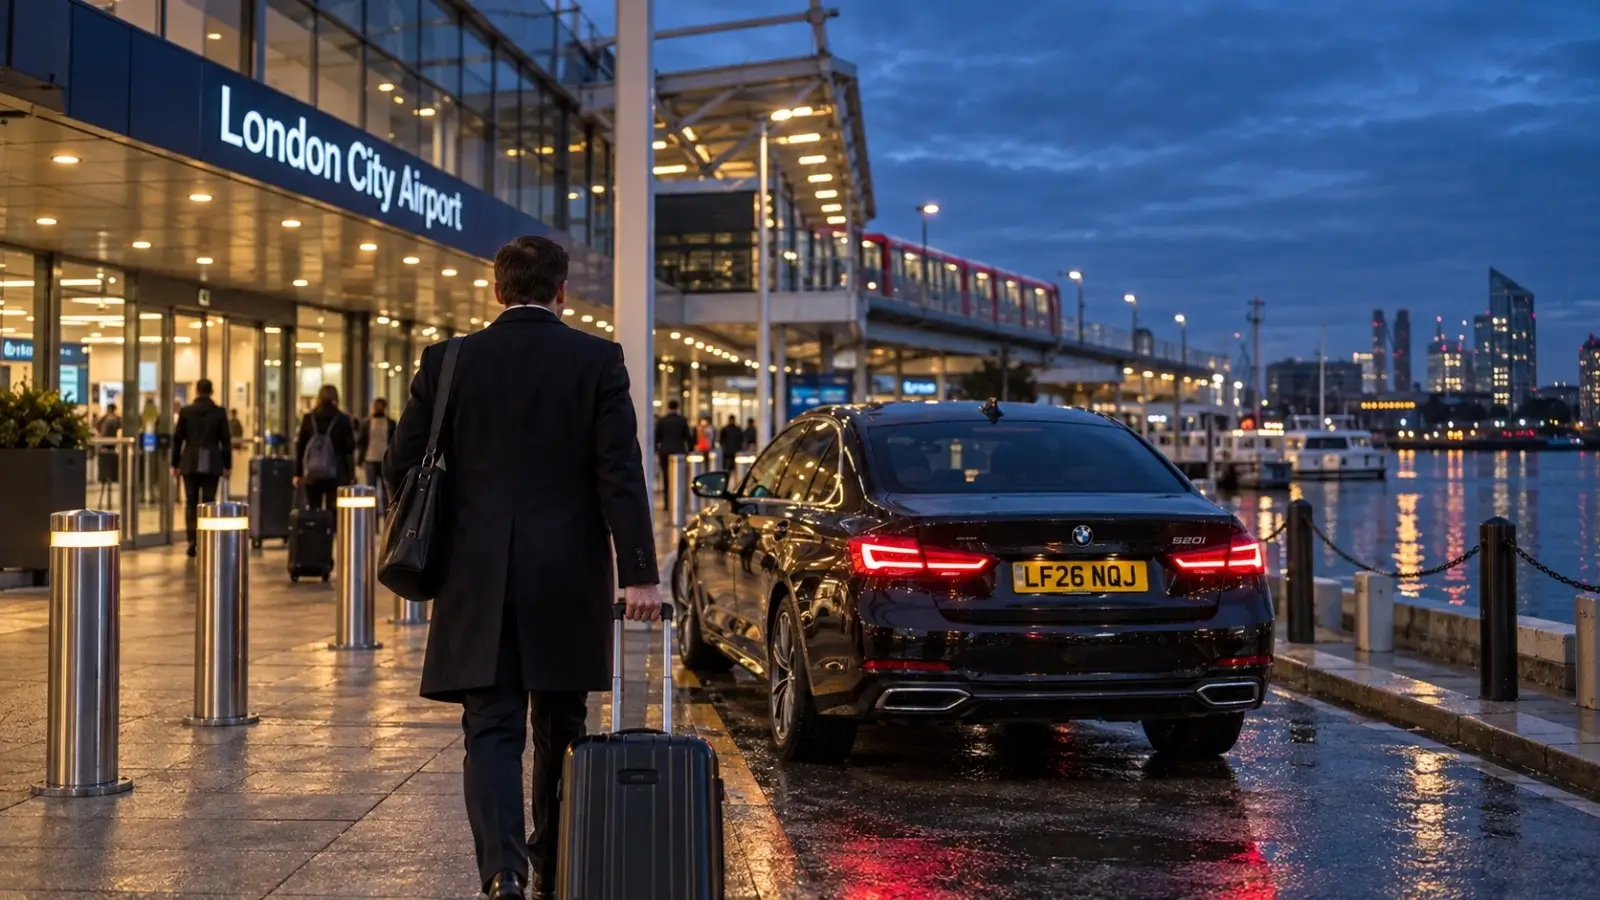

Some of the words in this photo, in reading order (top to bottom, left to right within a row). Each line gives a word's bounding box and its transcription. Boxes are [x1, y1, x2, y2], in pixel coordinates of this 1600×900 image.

[221, 85, 341, 183] London
[348, 141, 395, 213] City
[398, 165, 462, 231] Airport
[1024, 565, 1085, 587] LF26
[1091, 565, 1136, 588] NQJ
